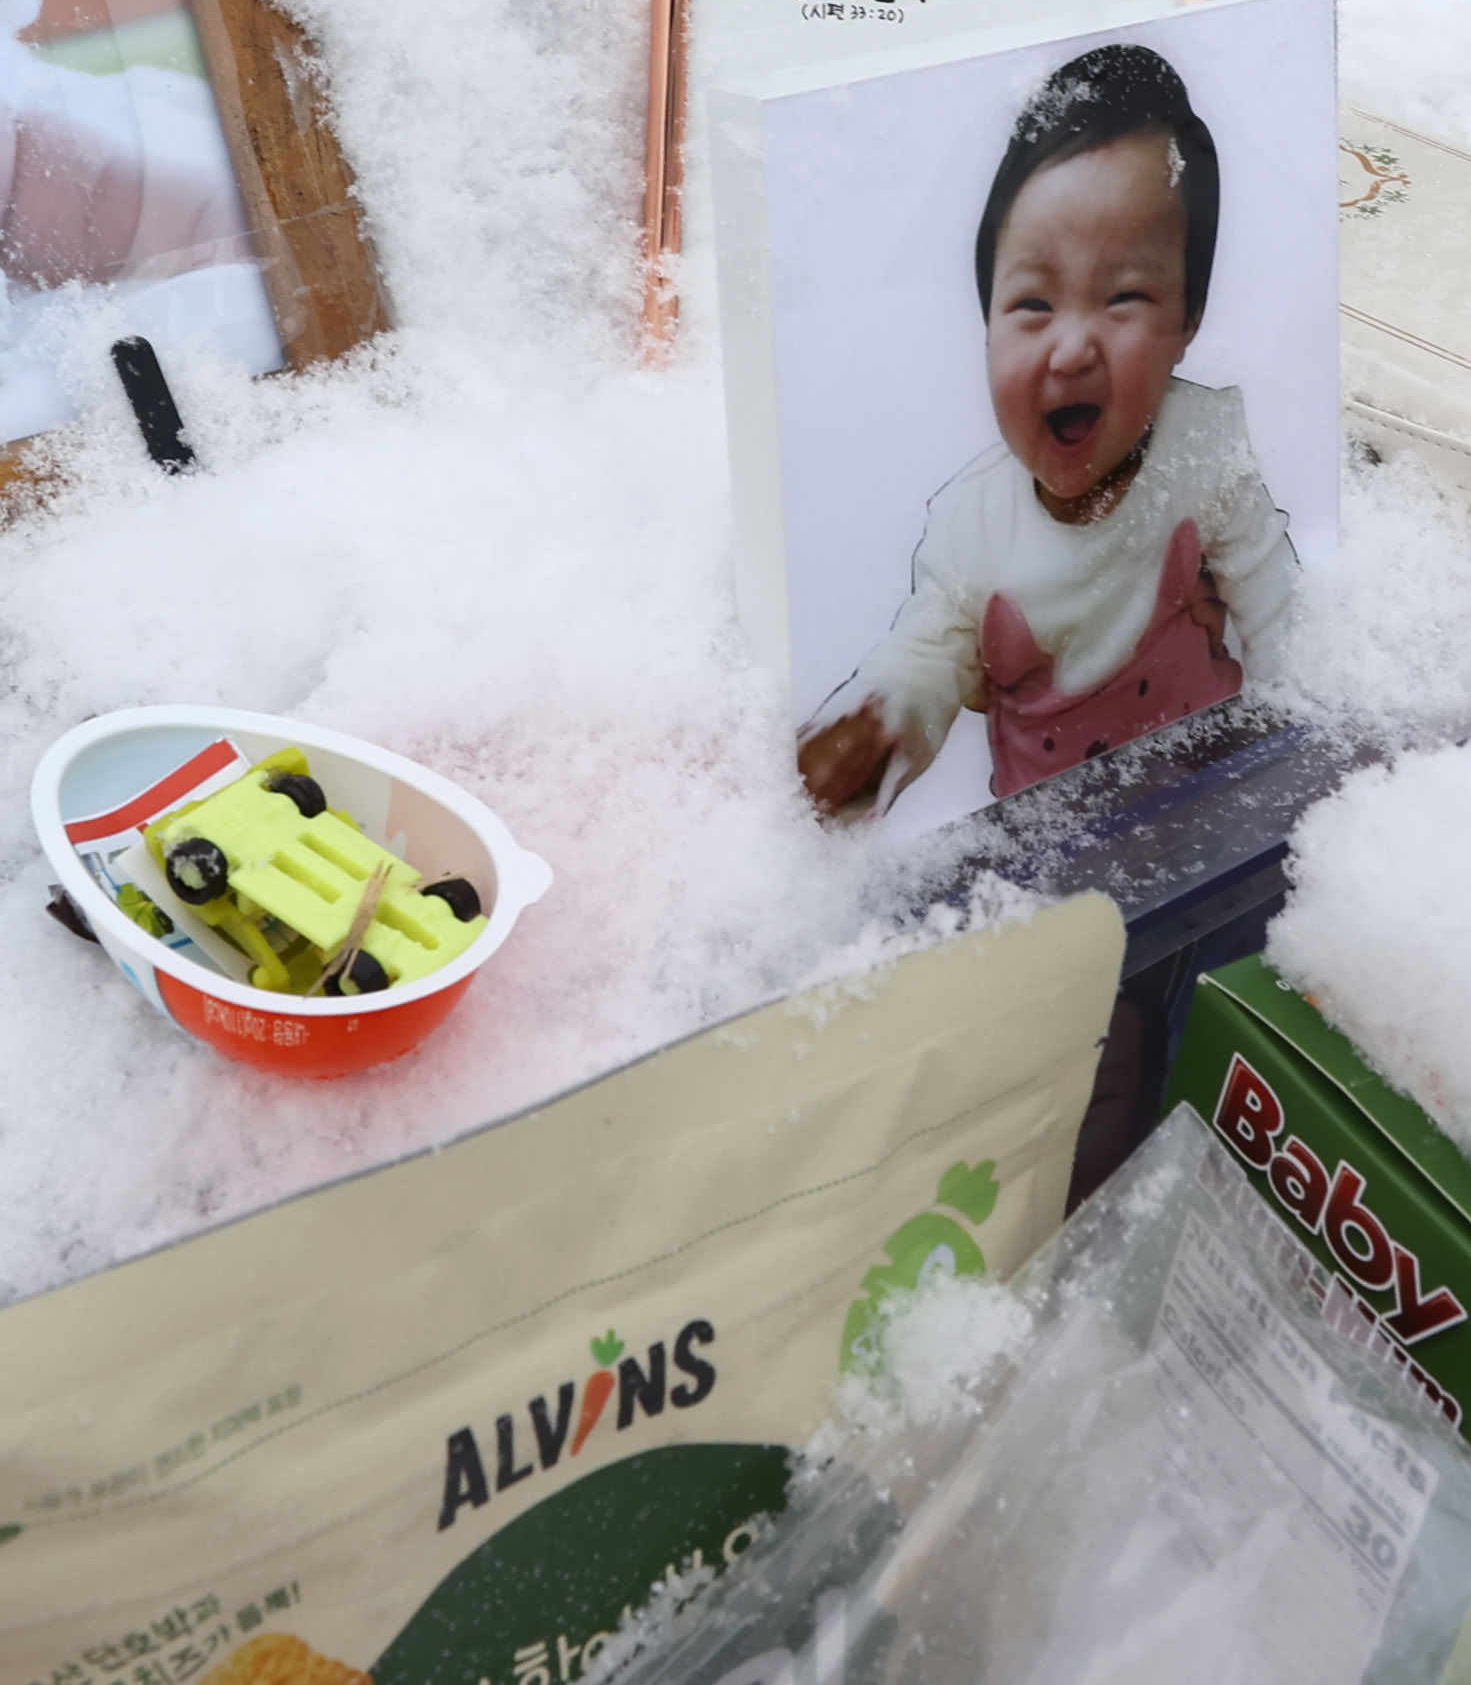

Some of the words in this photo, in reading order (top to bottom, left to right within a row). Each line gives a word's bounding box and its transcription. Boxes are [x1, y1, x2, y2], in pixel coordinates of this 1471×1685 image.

[801, 3, 845, 21] (시편
[1213, 1051, 1468, 1344] Baby
[437, 1319, 716, 1532] ALVINS
[1343, 1500, 1397, 1575] 30
